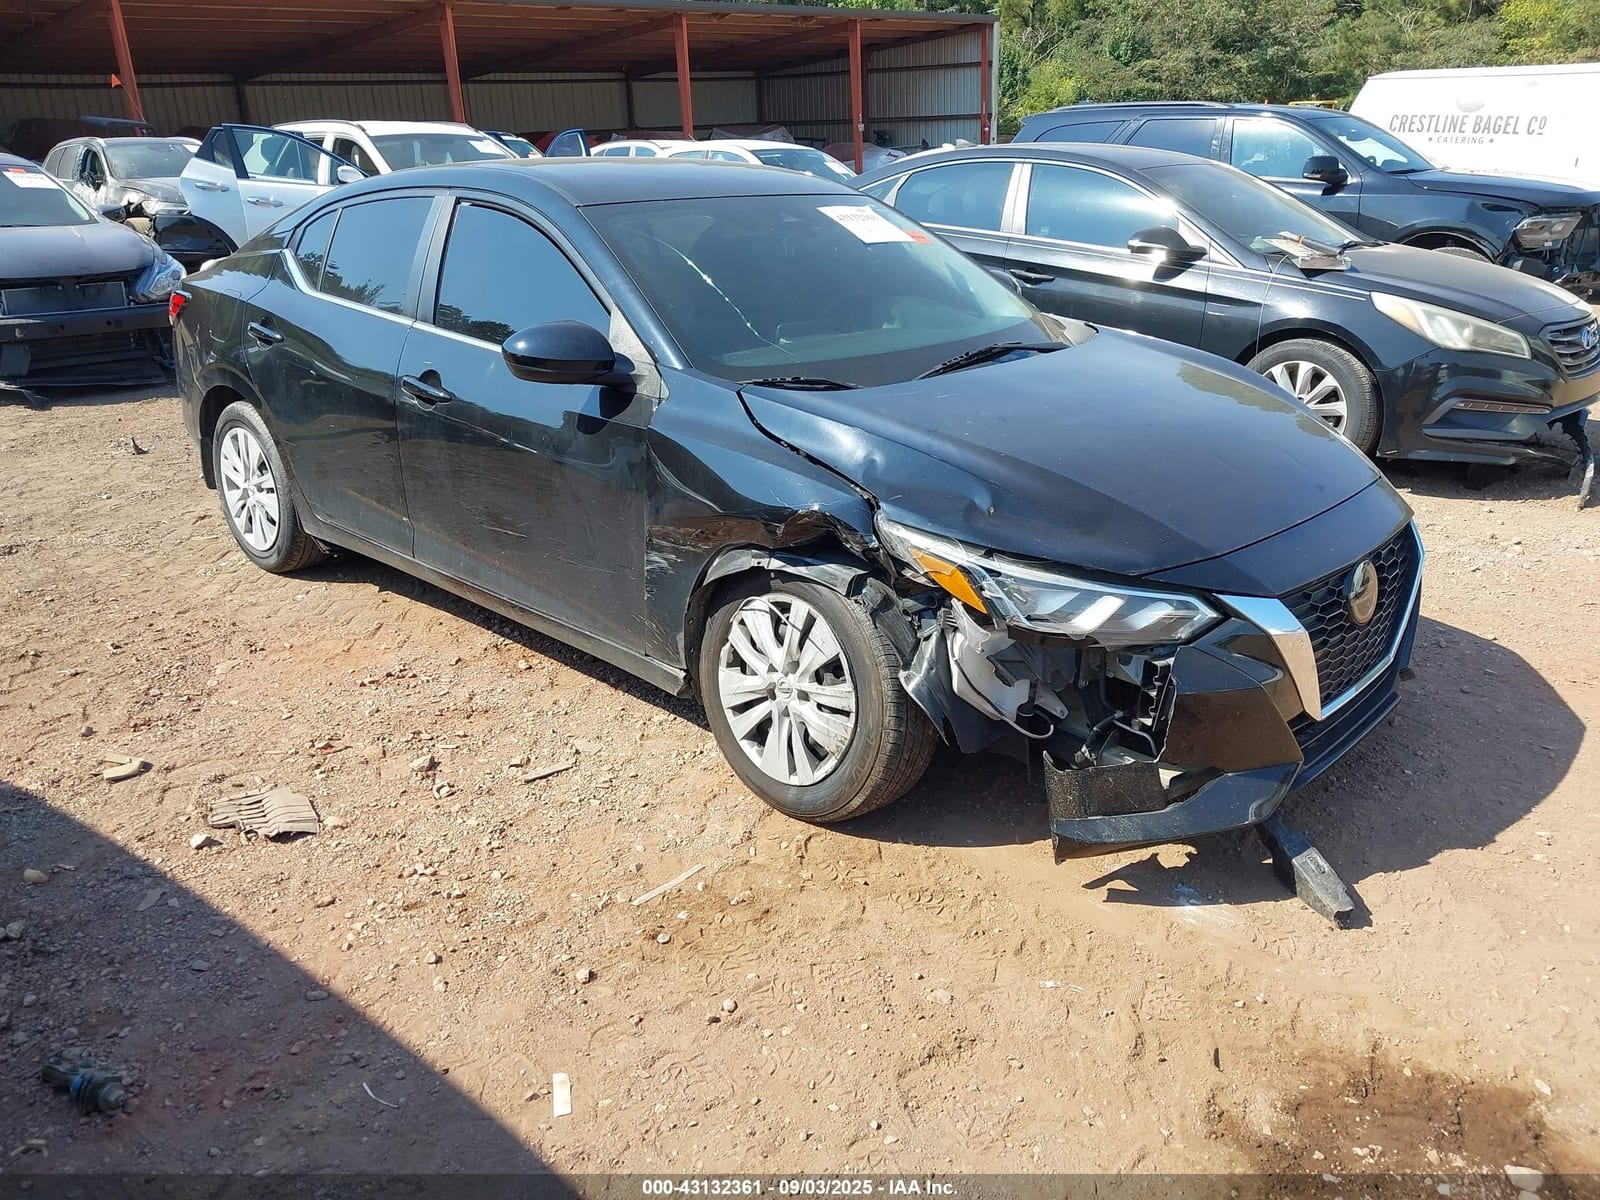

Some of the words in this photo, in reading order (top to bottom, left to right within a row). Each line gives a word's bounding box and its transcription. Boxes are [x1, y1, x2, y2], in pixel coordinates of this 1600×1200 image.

[1389, 114, 1469, 133] CRESTLINE
[1472, 115, 1520, 135] BAGEL
[1436, 136, 1485, 145] CATERING
